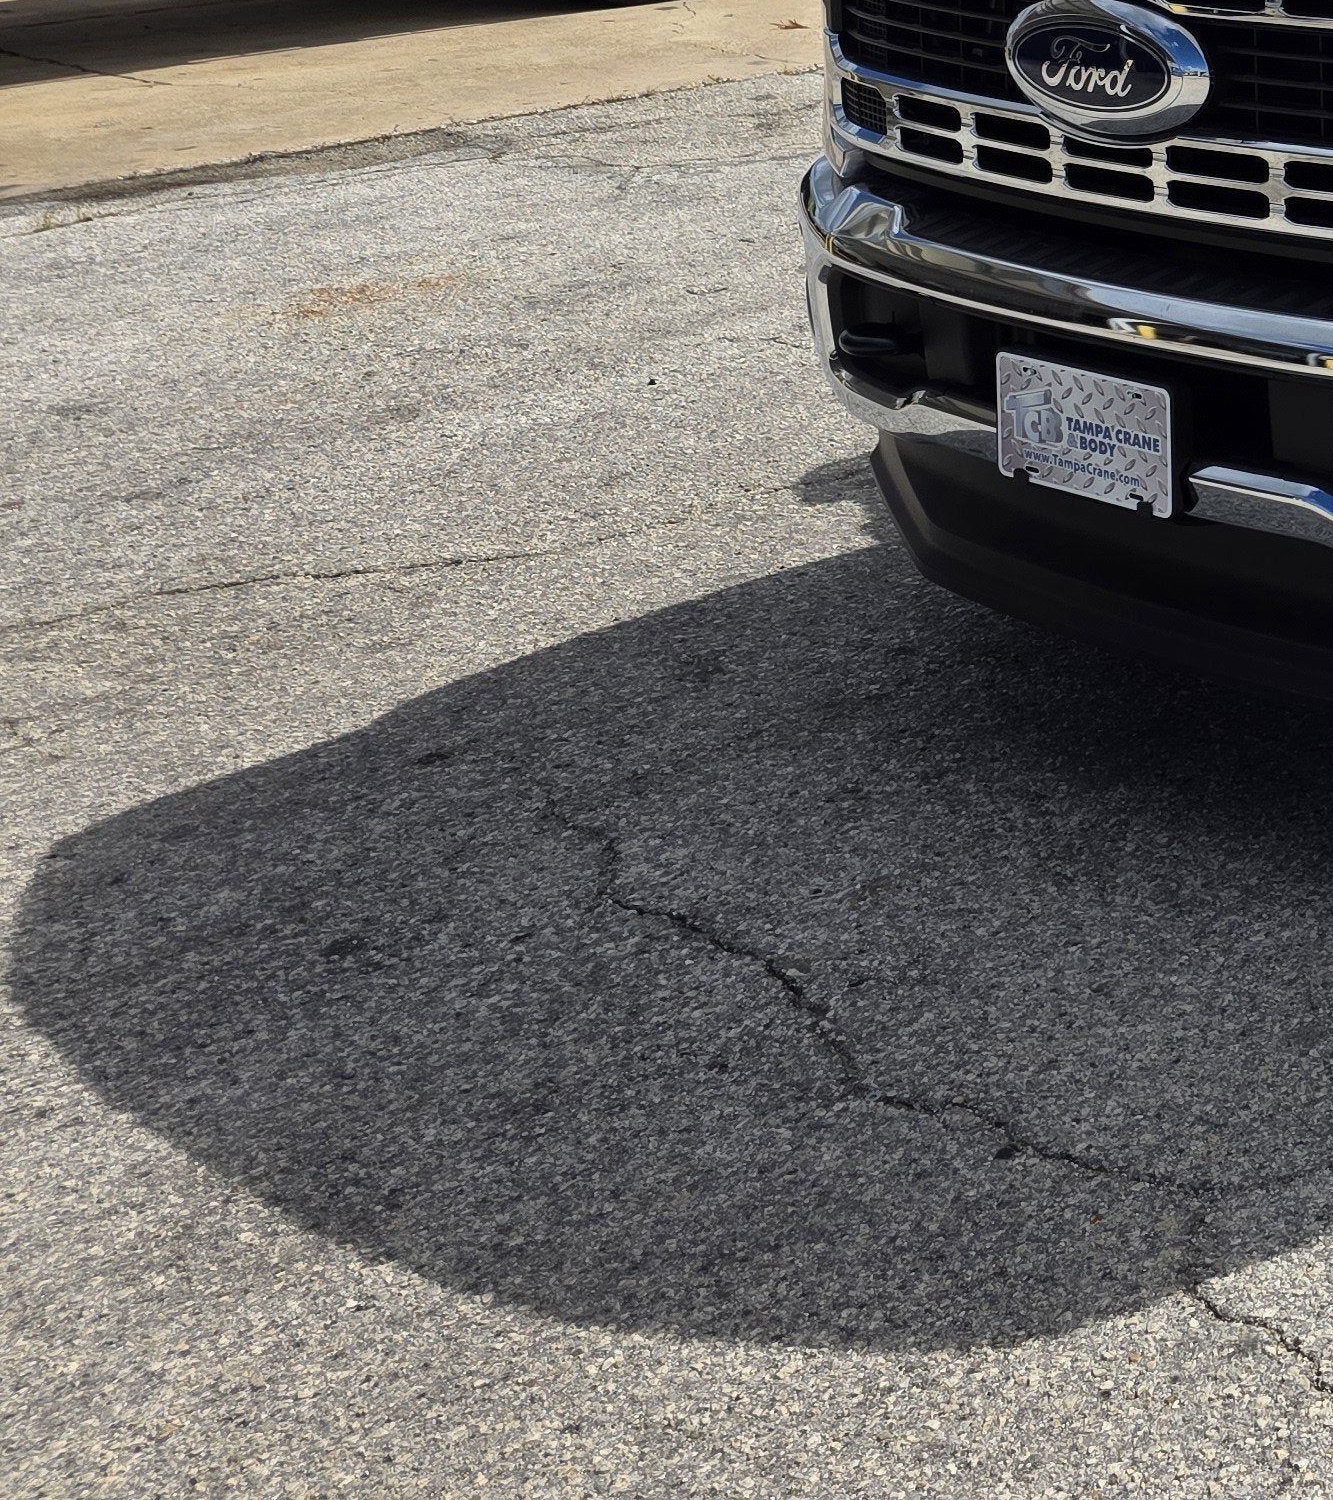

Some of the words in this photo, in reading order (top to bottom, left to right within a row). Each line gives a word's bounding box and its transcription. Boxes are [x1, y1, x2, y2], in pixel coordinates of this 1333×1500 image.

[1041, 34, 1134, 98] Ford
[1066, 416, 1113, 442] TAMPA
[1115, 428, 1160, 453] CRANE
[1066, 432, 1079, 449] &
[1079, 435, 1117, 458] BODY
[1024, 449, 1141, 488] www.TampaCrane.com
